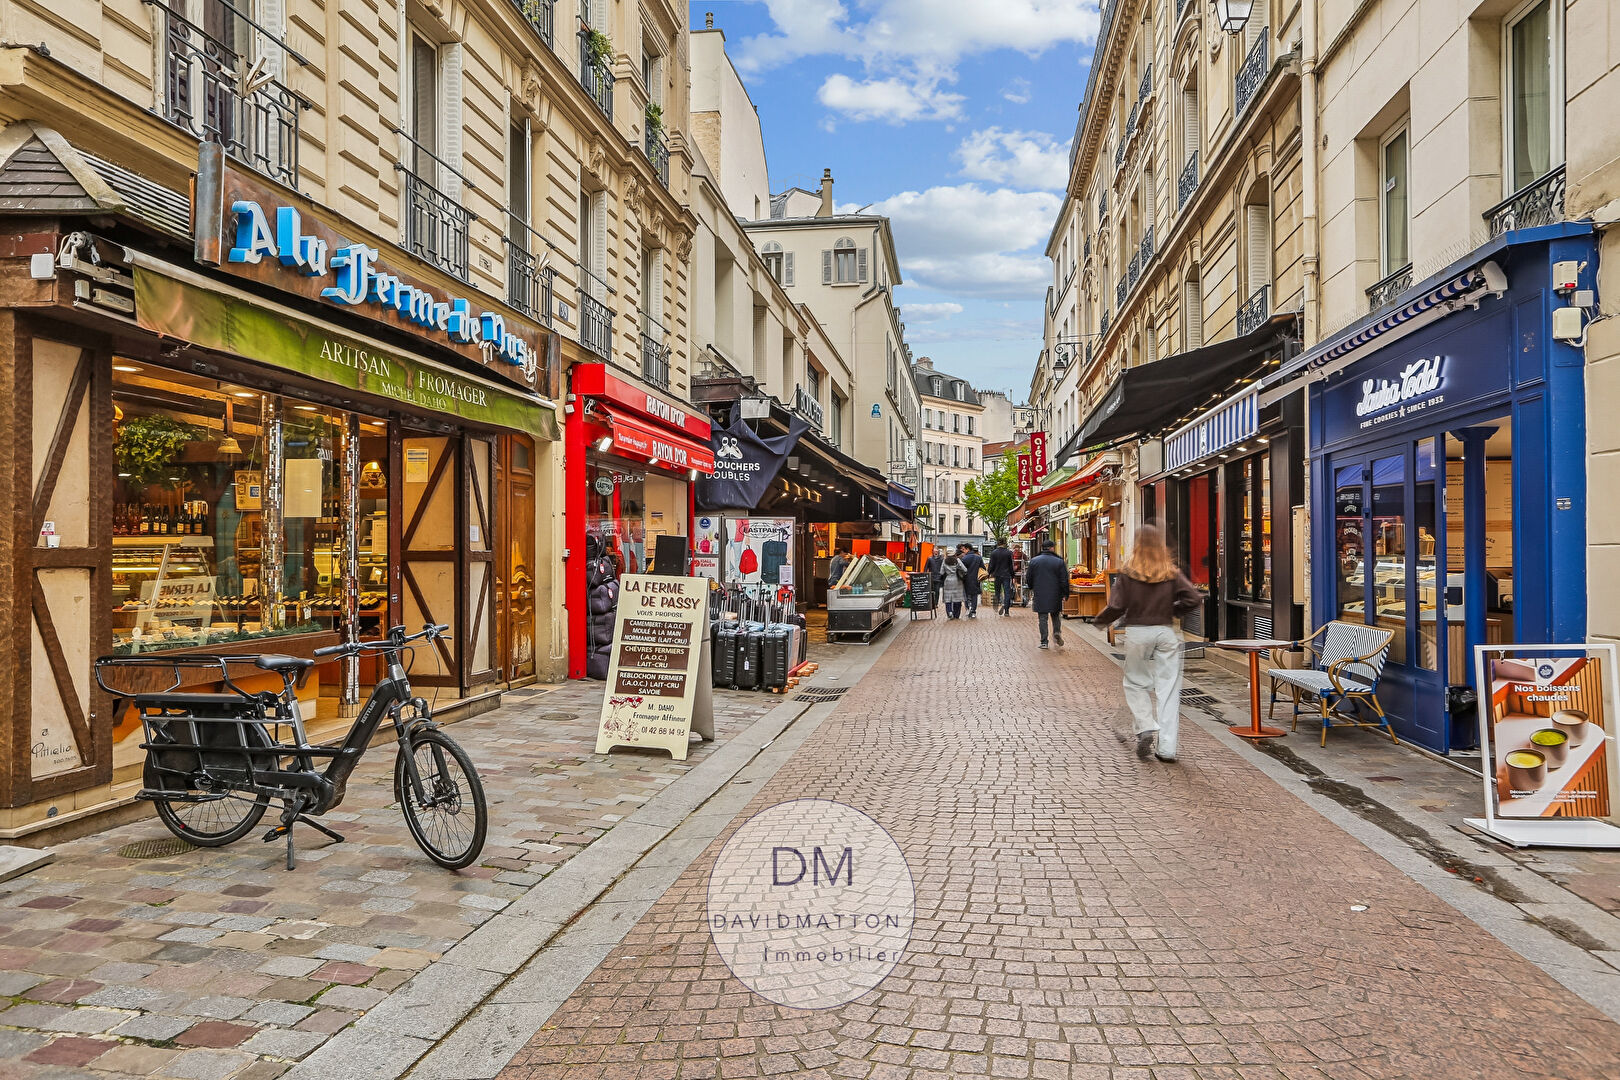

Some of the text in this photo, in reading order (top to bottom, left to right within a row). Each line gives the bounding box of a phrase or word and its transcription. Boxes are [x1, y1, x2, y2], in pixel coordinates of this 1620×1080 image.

[319, 340, 488, 407] ARTISAN FROMAGER
[1356, 355, 1441, 417] Laura Todd
[381, 381, 447, 410] MICHEL DAHO
[645, 395, 686, 428] RAYON D'OR
[1360, 395, 1444, 429] FINE COOKIES SINCE 1933
[652, 440, 674, 461] RAYON
[674, 447, 688, 465] D'OR
[706, 471, 751, 481] DOUBLES
[625, 581, 685, 595] LA FERME
[641, 595, 701, 610] DE PASSY
[624, 634, 688, 645] NORMANDIE (LAIT-CRU)
[619, 672, 656, 680] REBLOCHON
[1514, 684, 1581, 693] Nos boissons
[1526, 693, 1569, 702] chaudes
[361, 699, 377, 724] KETTLER
[658, 704, 675, 712] DAHO
[632, 712, 660, 722] Fromager
[641, 726, 648, 734] 01
[648, 727, 657, 735] 42
[669, 728, 675, 736] 14
